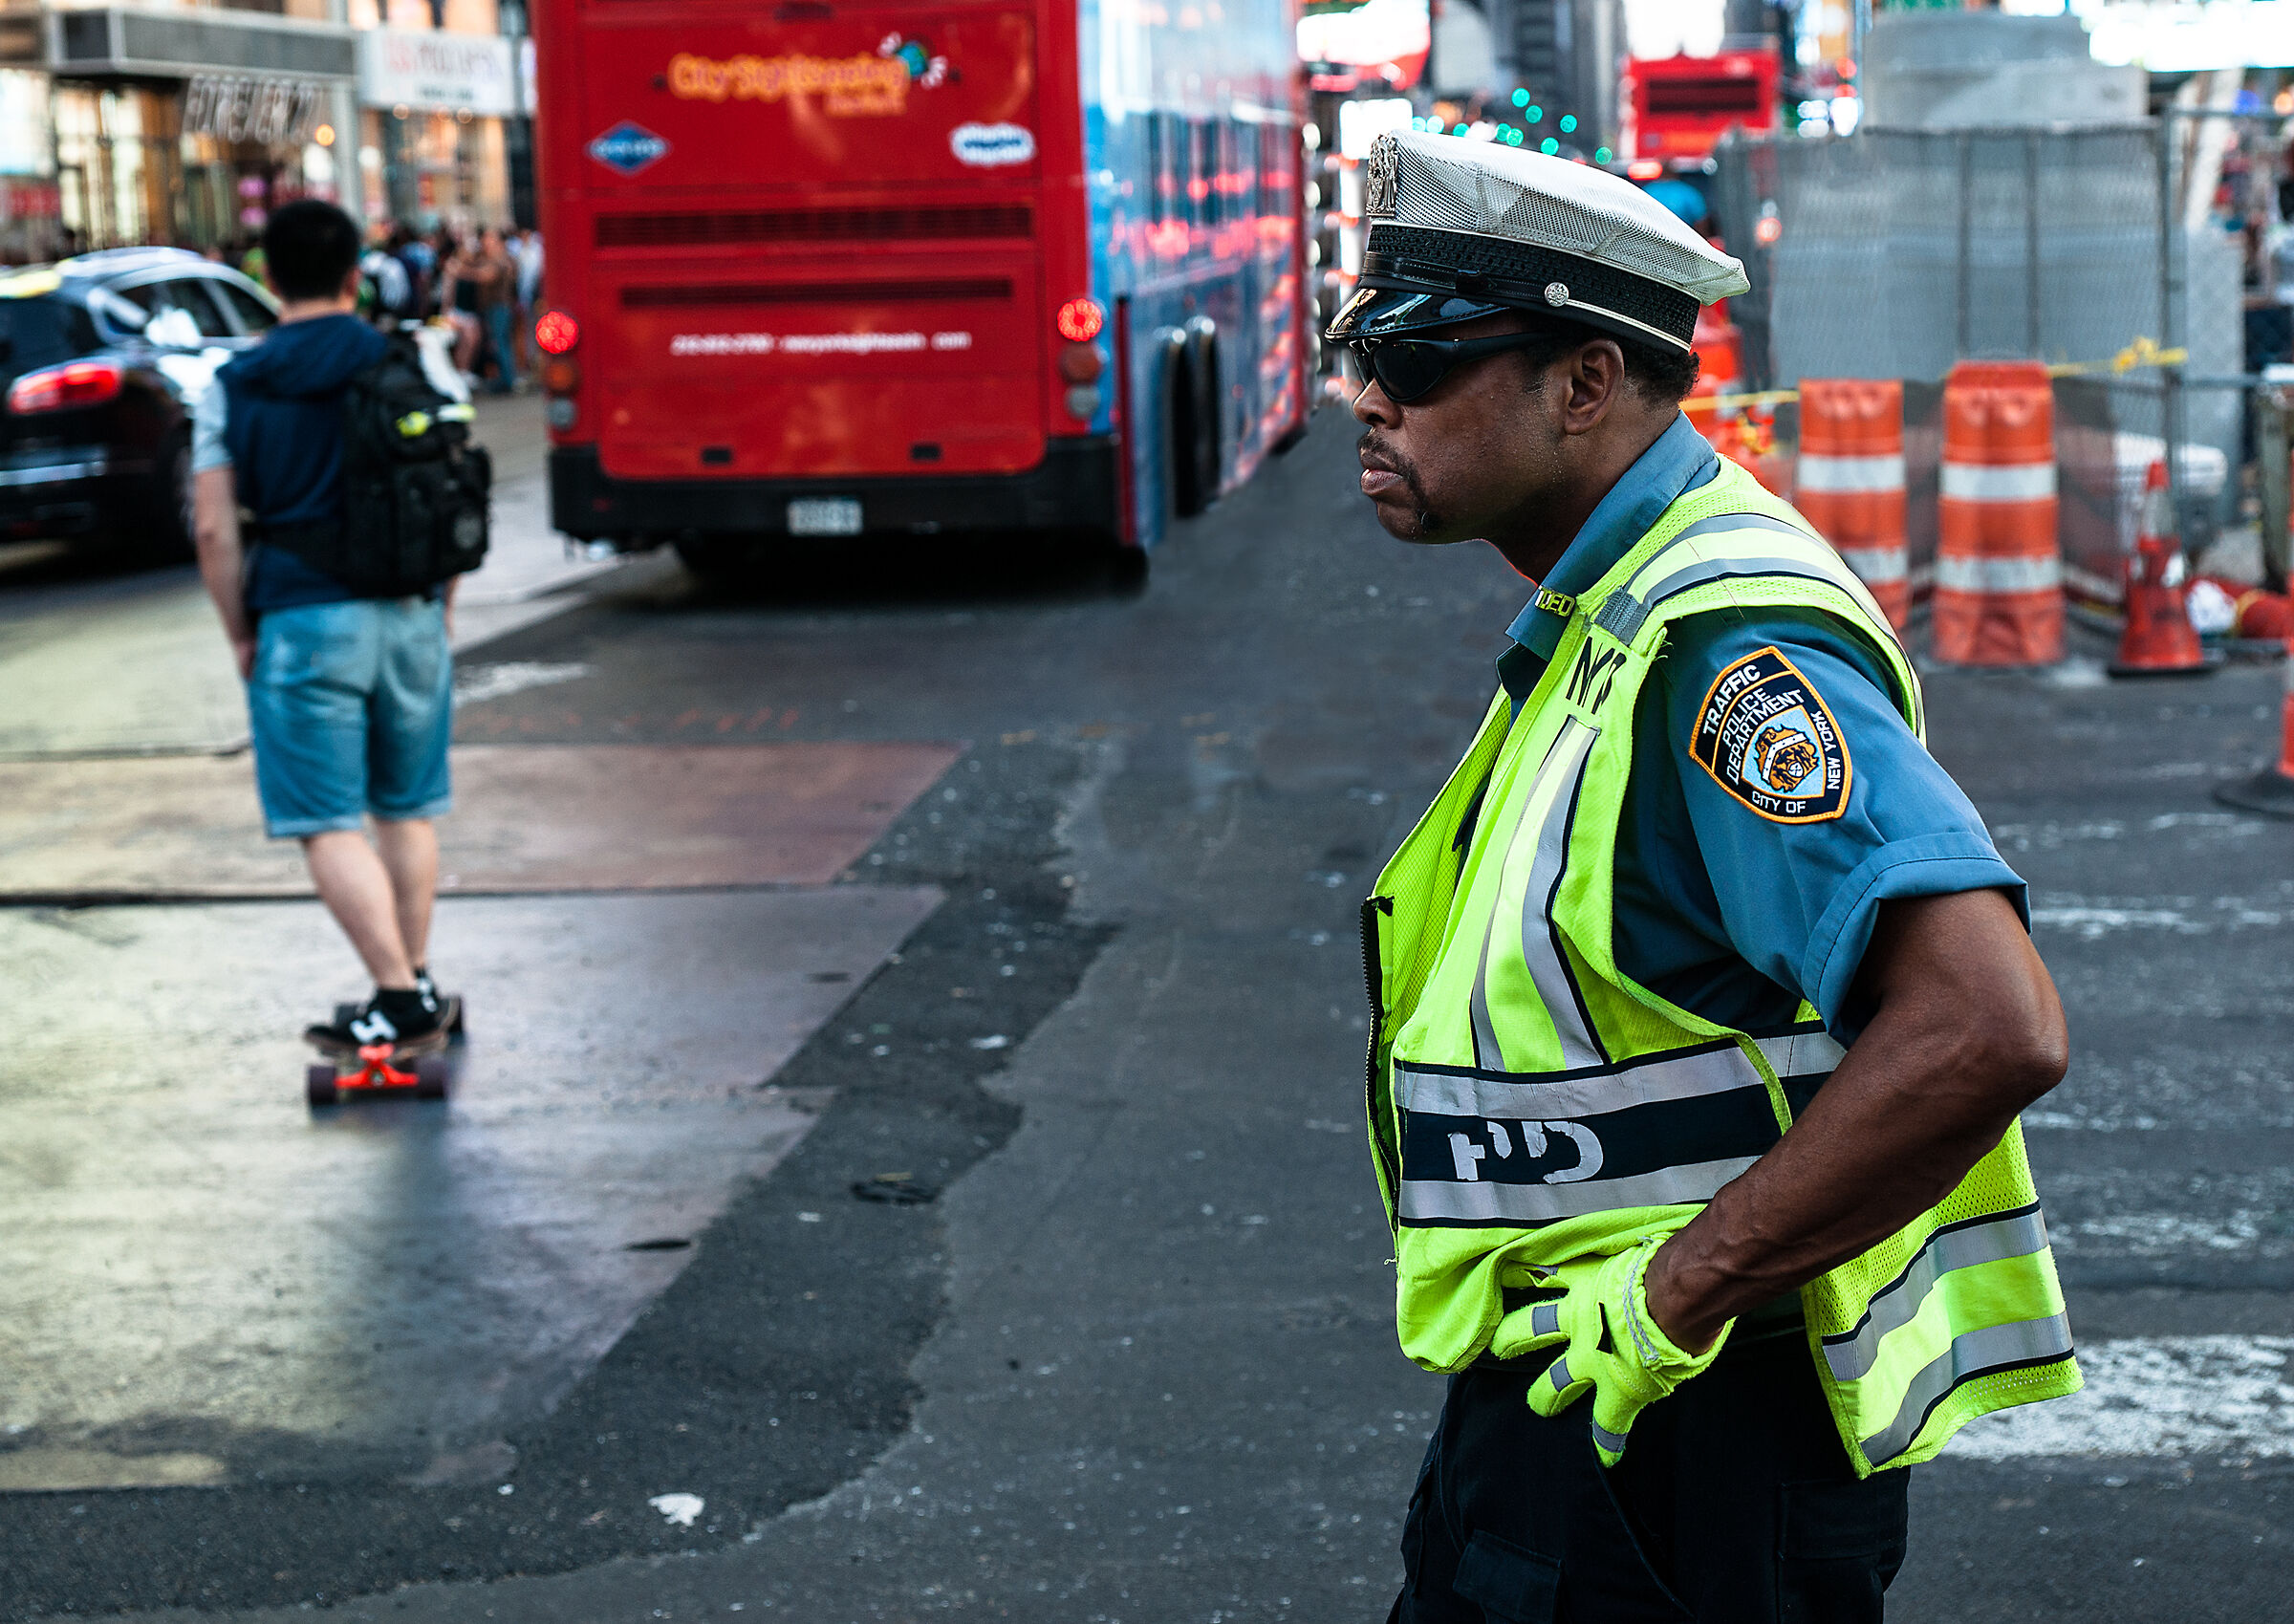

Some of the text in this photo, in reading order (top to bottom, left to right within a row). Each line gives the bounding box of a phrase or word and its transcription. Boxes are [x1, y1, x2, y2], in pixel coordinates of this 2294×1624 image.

[1702, 664, 1761, 735] TRAFFIC
[1722, 687, 1771, 747] POLICE
[1726, 689, 1805, 785] DEPARTMENT
[1752, 710, 1841, 813] CITY OF NEW YORK
